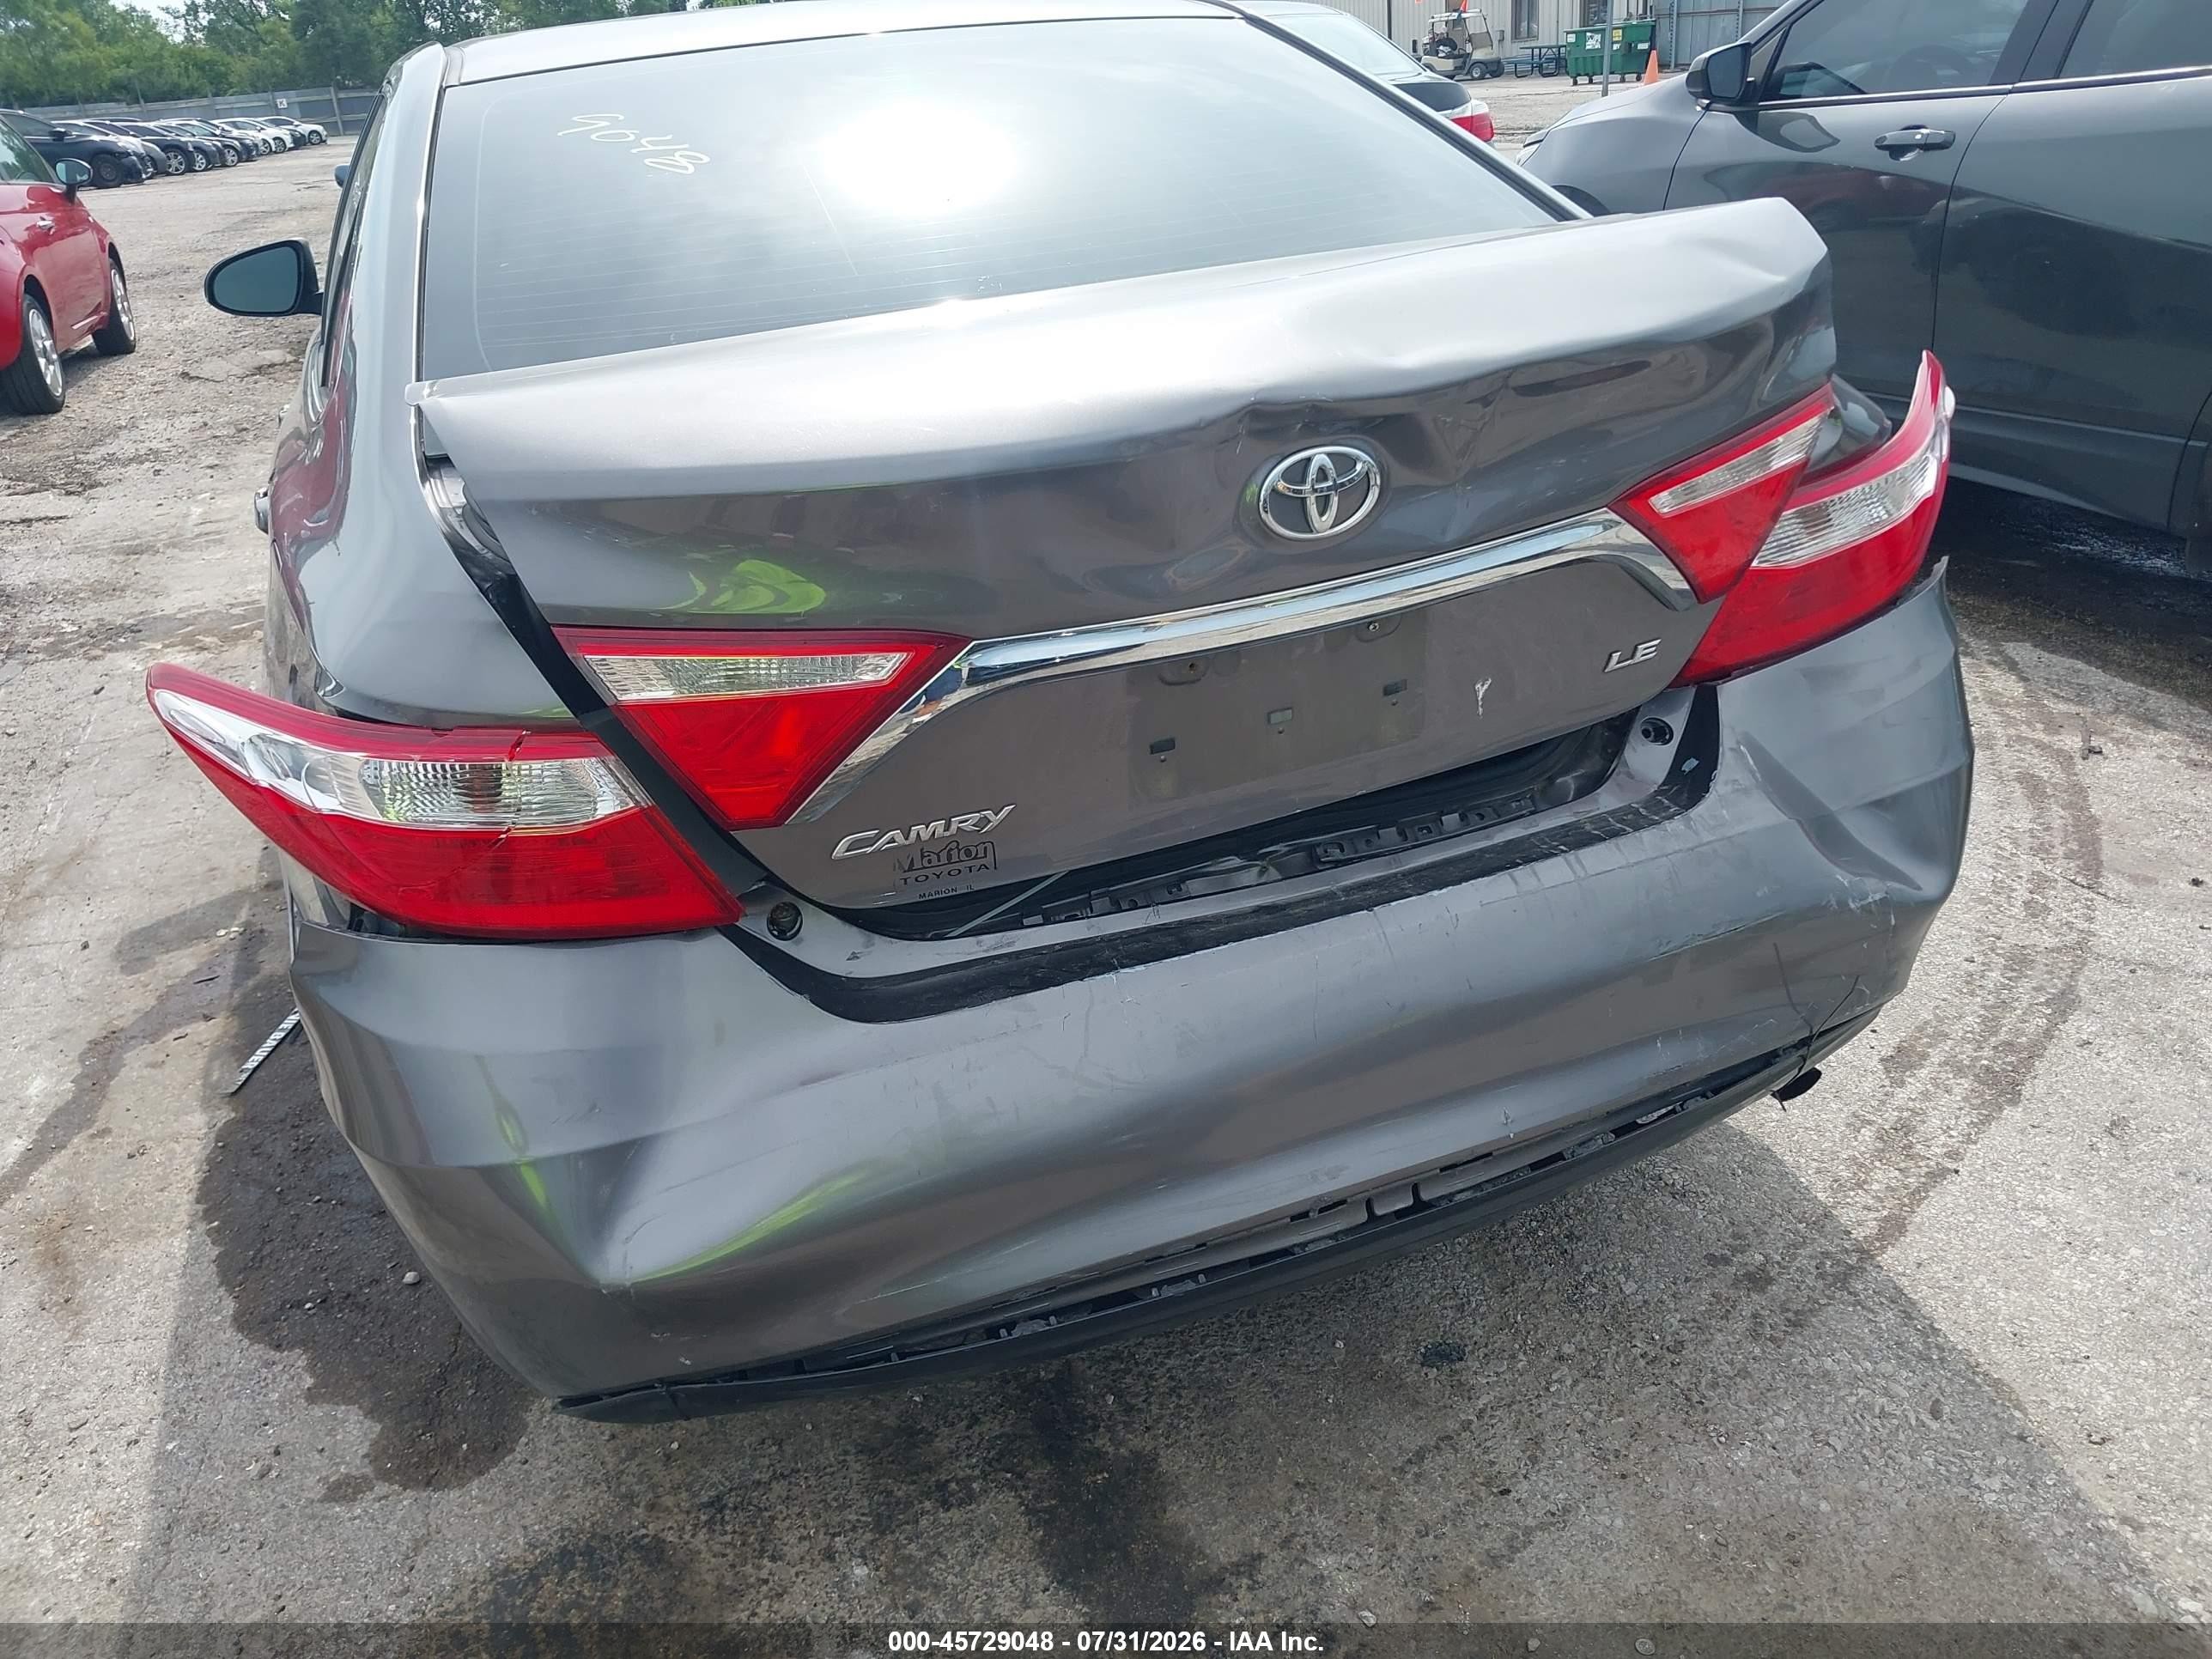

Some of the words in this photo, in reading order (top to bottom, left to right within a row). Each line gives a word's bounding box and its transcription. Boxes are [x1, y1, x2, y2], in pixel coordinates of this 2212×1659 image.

[1602, 638, 1662, 673] LE
[831, 804, 1017, 860] CAMRY
[900, 864, 990, 885] TOYOTA
[918, 887, 958, 900] MARION
[240, 1031, 287, 1069] BAUER
